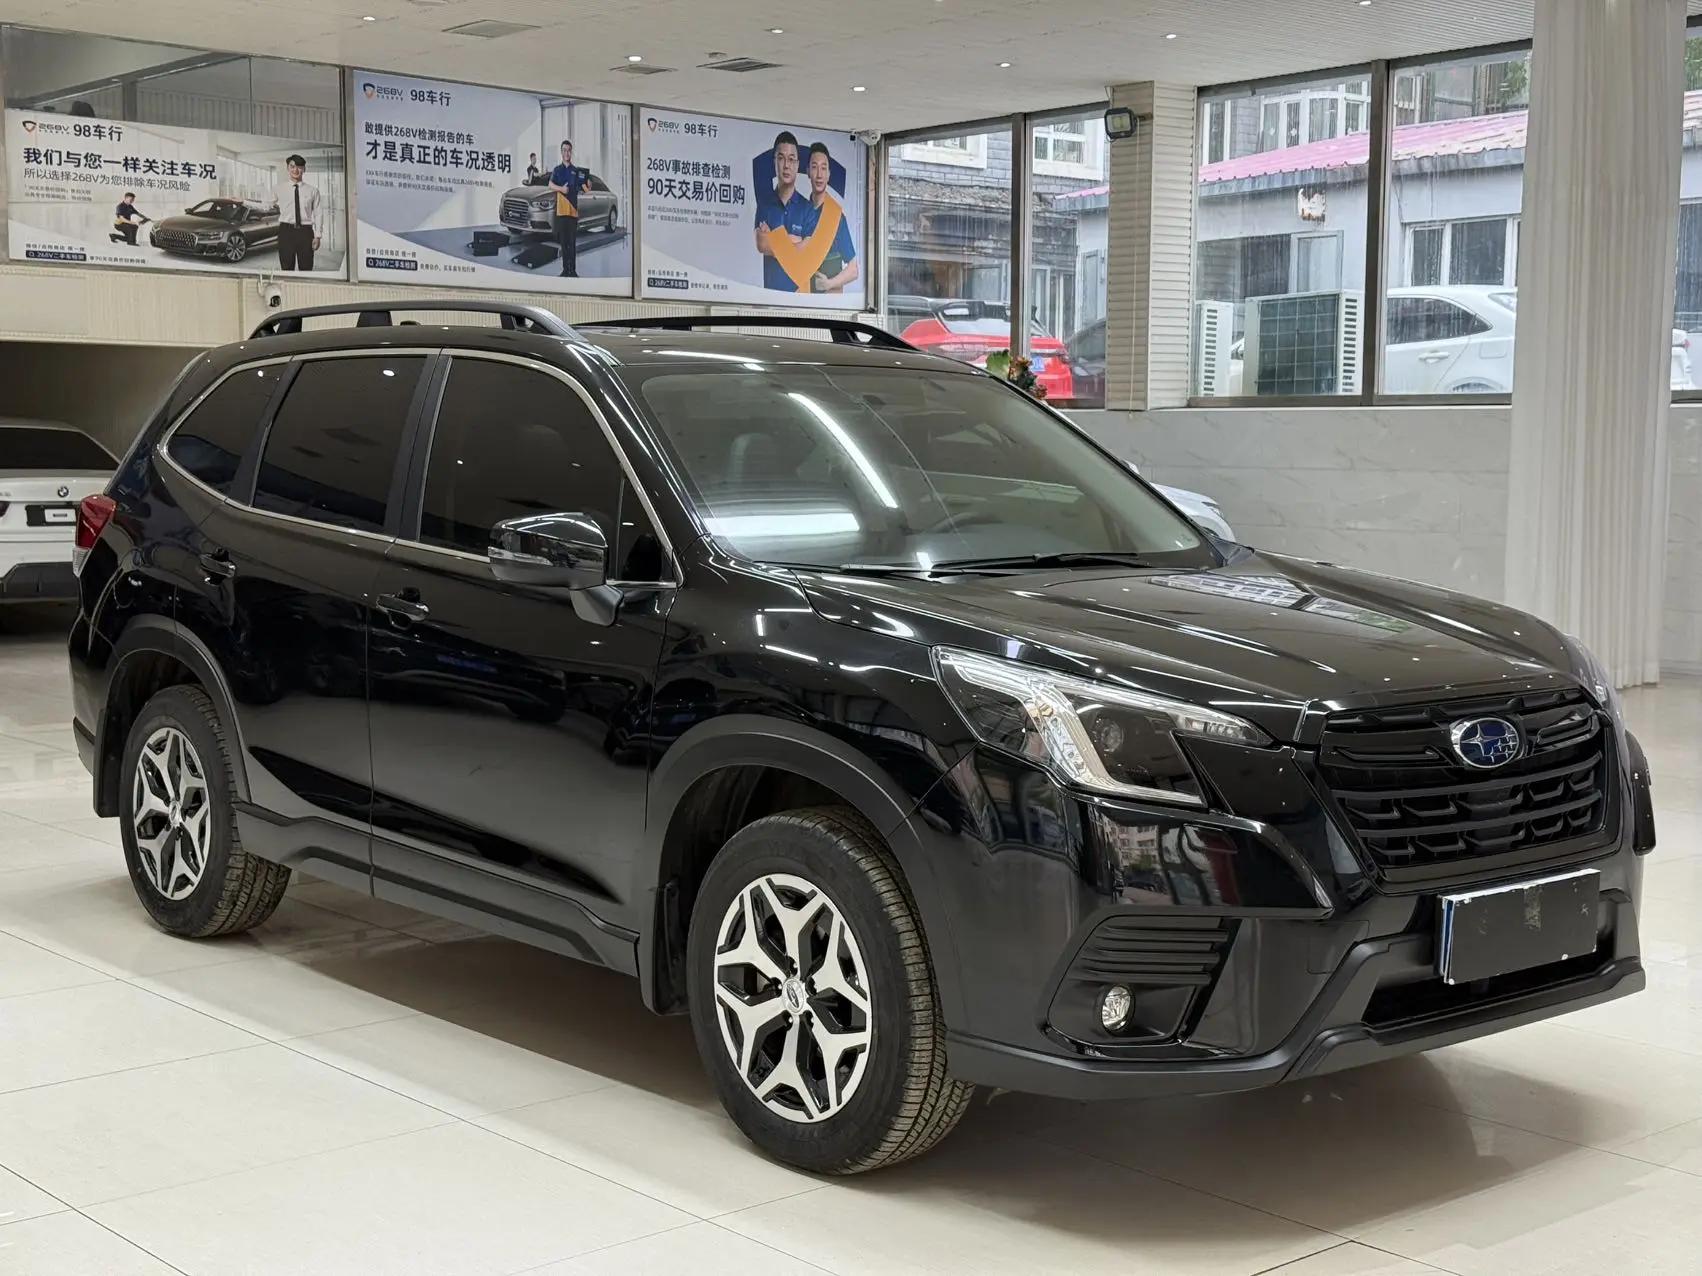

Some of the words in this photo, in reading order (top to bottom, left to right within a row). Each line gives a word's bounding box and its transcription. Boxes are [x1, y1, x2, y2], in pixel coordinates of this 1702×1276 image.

[376, 86, 404, 97] 268V
[410, 89, 452, 107] 98车行
[73, 123, 123, 142] 98车行
[364, 121, 475, 146] 敢提供268V检测报告的车
[684, 122, 718, 138] 98车行
[23, 146, 217, 180] 我们与您一样关注车况
[365, 140, 512, 174] 才是真正的车况透明
[647, 157, 731, 180] 268V事故排查检测
[23, 167, 191, 193] 所以选择268V为您排除车况风险
[647, 178, 746, 205] 90天交易价回购
